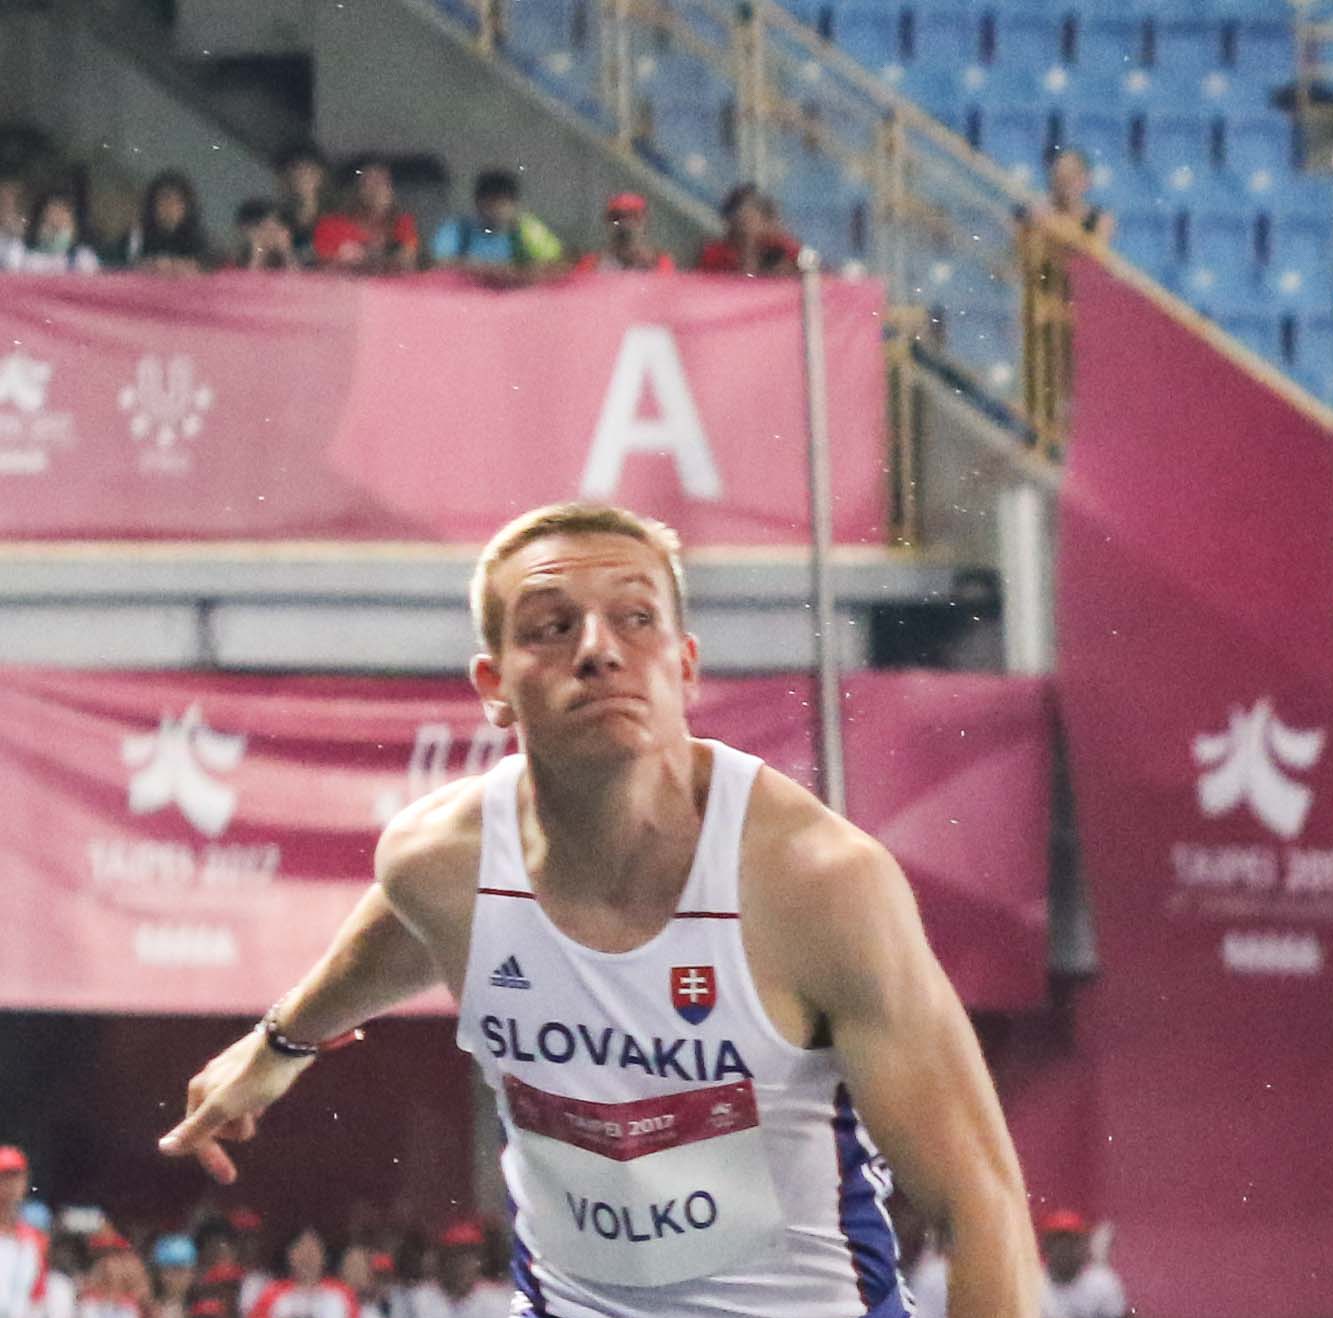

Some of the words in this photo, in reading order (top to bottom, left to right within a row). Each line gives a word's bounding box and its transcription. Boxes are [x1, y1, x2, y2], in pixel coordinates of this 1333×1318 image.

[579, 322, 725, 500] A
[480, 1014, 755, 1082] SLOVAKIA
[628, 1113, 676, 1137] 2017
[566, 1189, 718, 1242] VOLKO
